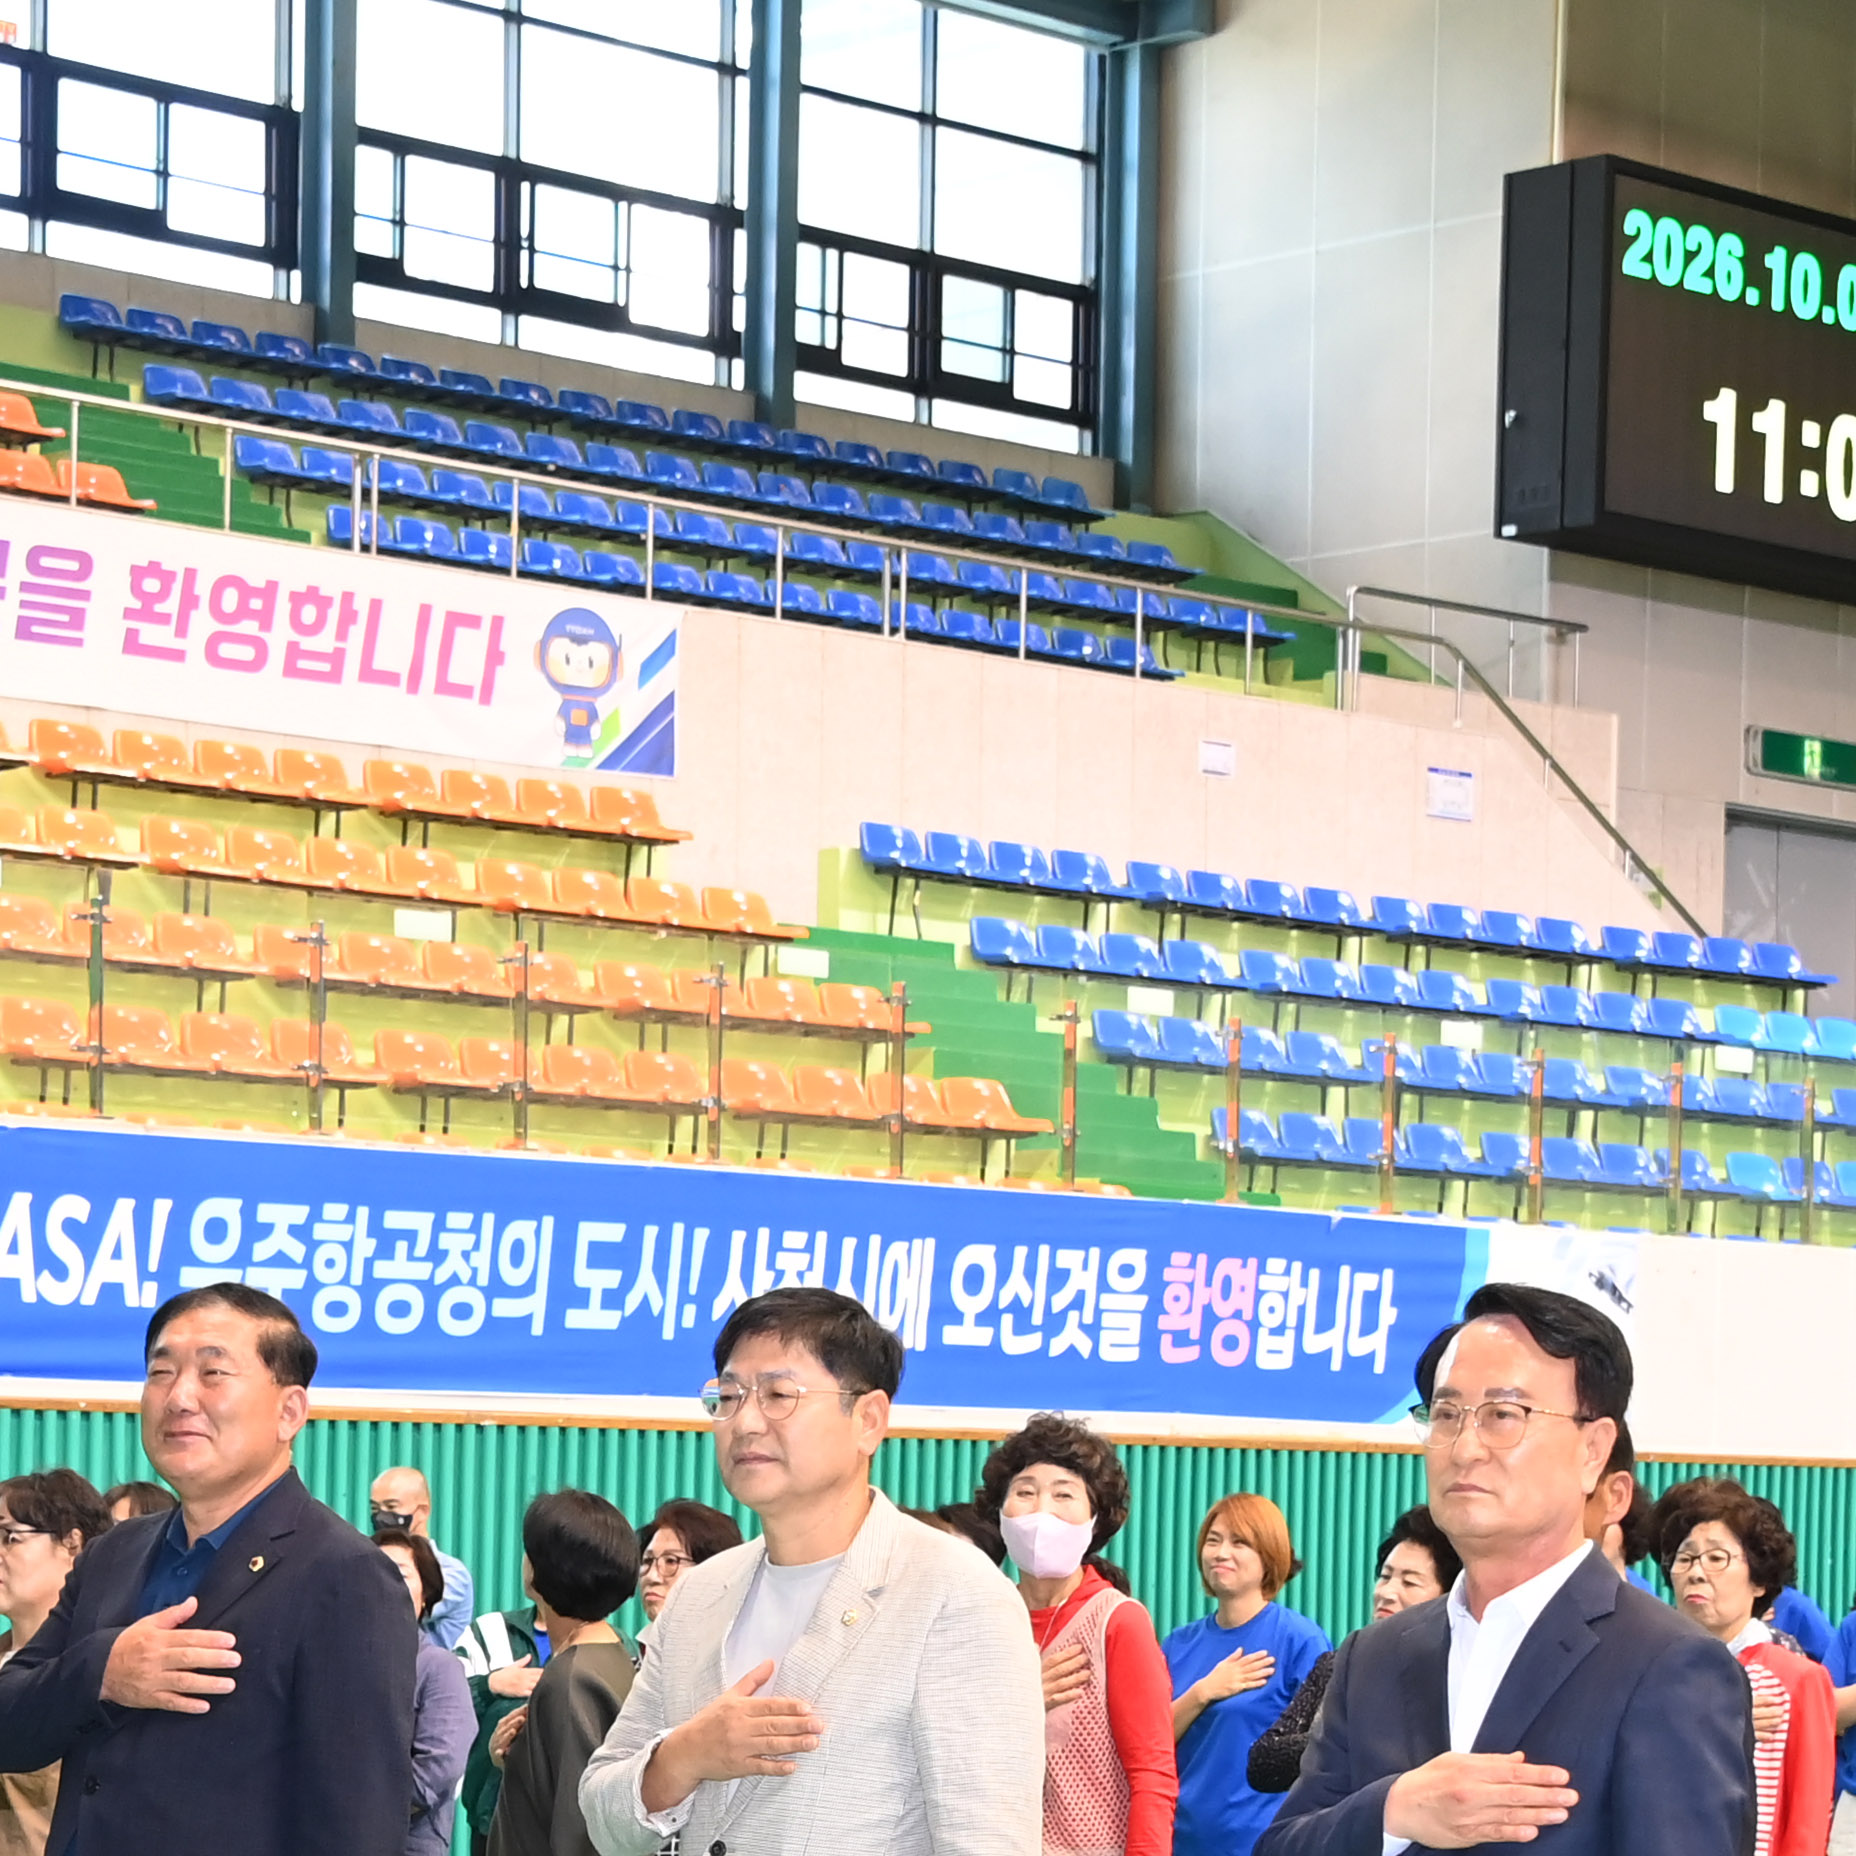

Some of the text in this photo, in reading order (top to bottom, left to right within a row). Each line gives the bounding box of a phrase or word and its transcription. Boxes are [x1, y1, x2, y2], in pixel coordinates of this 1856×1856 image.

[121, 559, 506, 706] 환영합니다
[178, 1197, 554, 1337] 우주항공청의
[564, 1221, 711, 1341] 도시!
[943, 1240, 1149, 1363] 오신것을
[1156, 1251, 1398, 1375] 환영합니다
